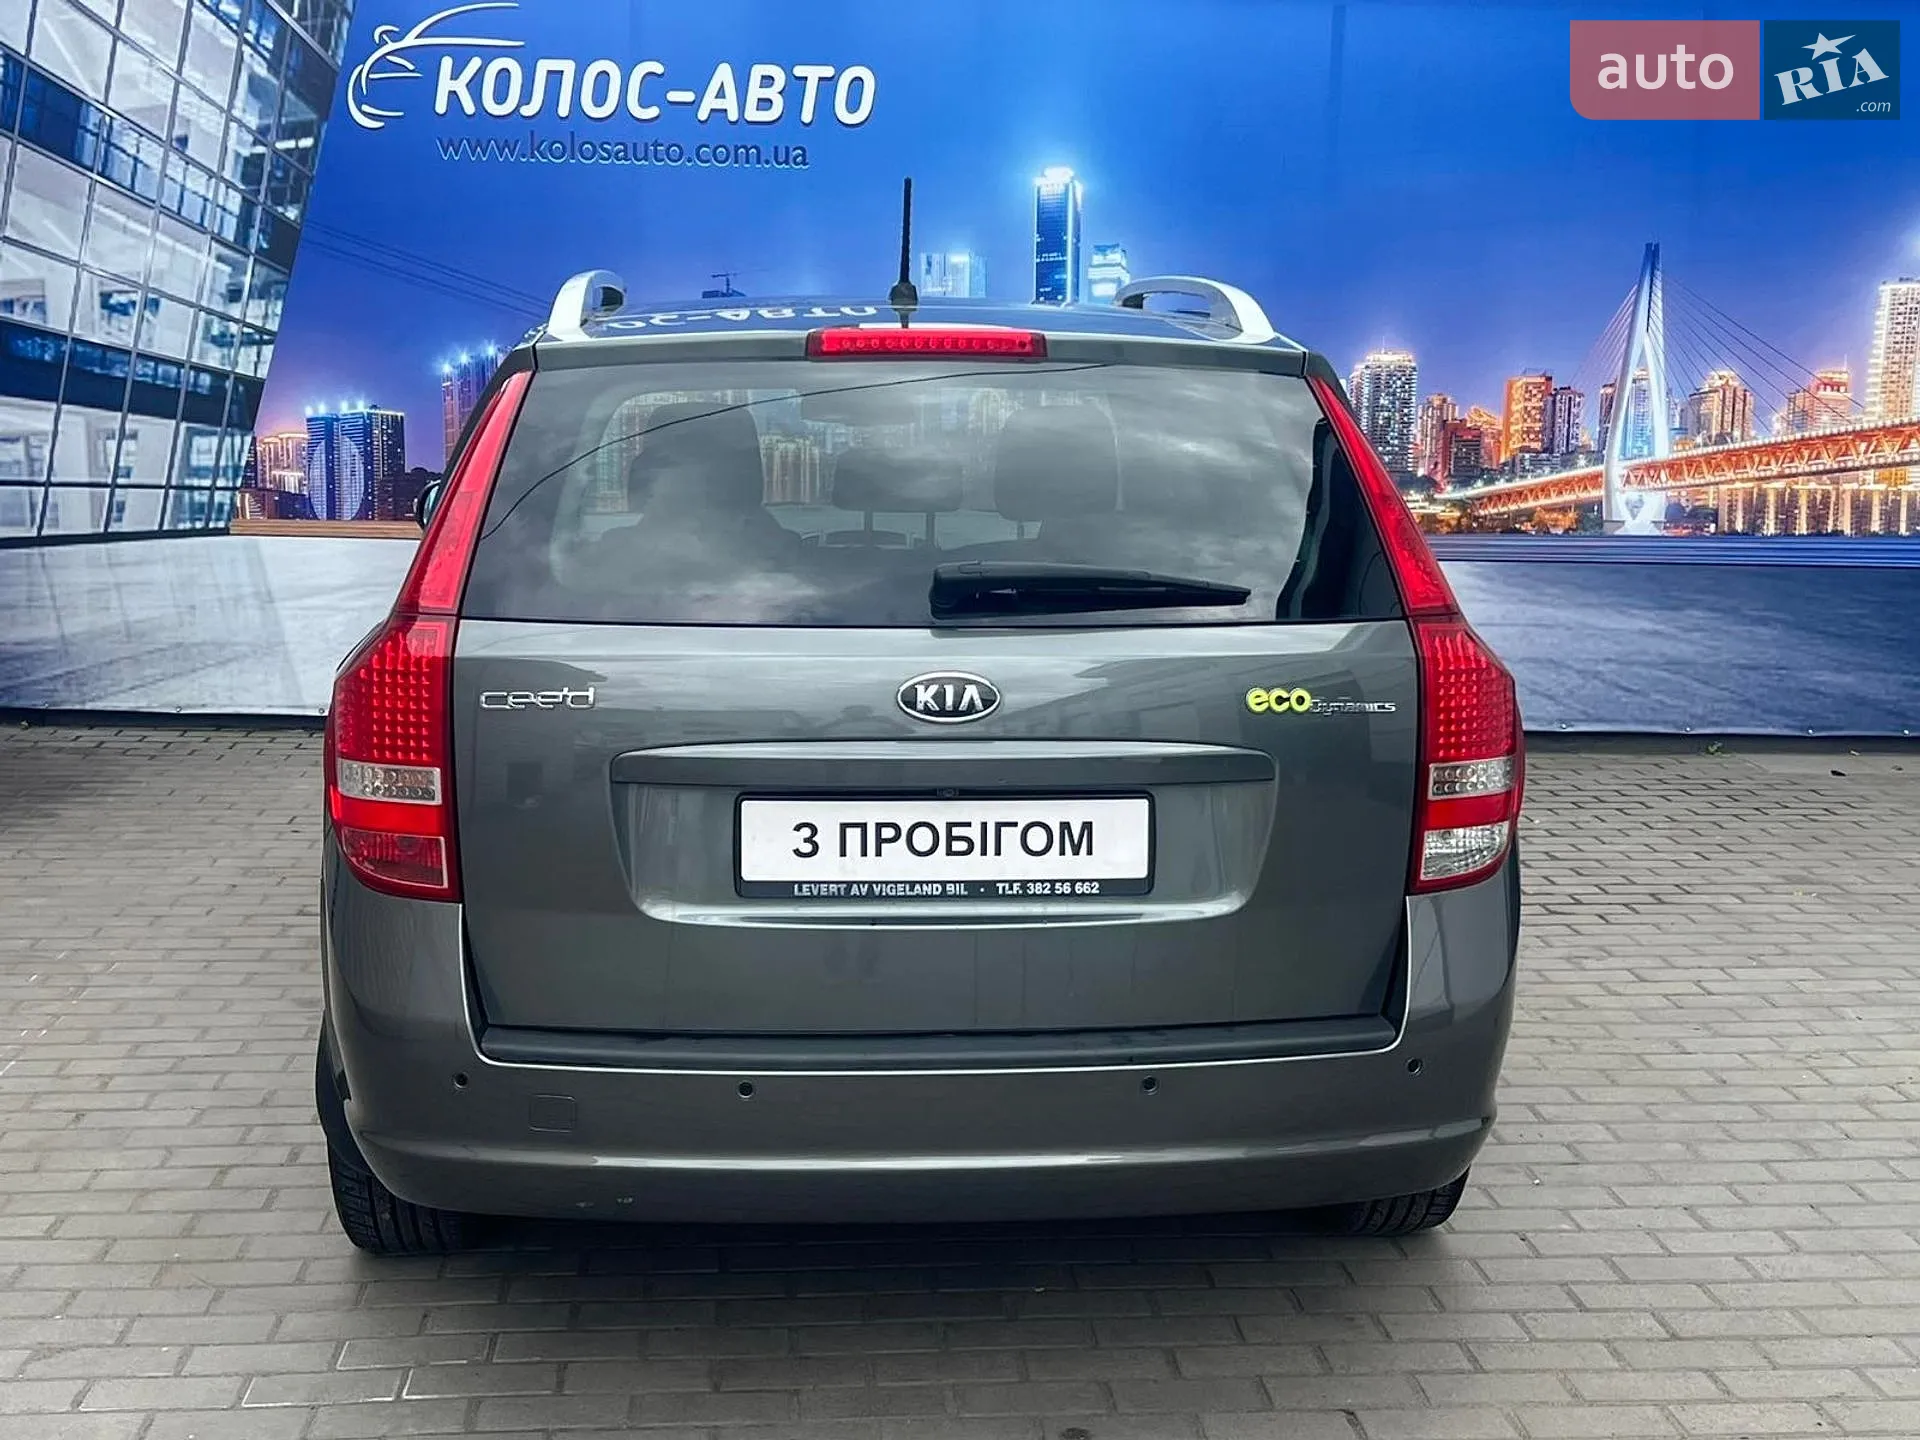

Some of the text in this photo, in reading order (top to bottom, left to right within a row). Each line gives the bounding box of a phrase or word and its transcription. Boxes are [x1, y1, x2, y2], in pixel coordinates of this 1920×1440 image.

[434, 55, 877, 126] КОЛОС-АВТО
[436, 131, 809, 169] www.kolosauto.com.ua
[914, 683, 985, 712] KIA
[838, 821, 1094, 858] ПРОБІГОМ
[793, 881, 1100, 897] LEVERT AV VIGELAND BIL TLF. 382 56 662
